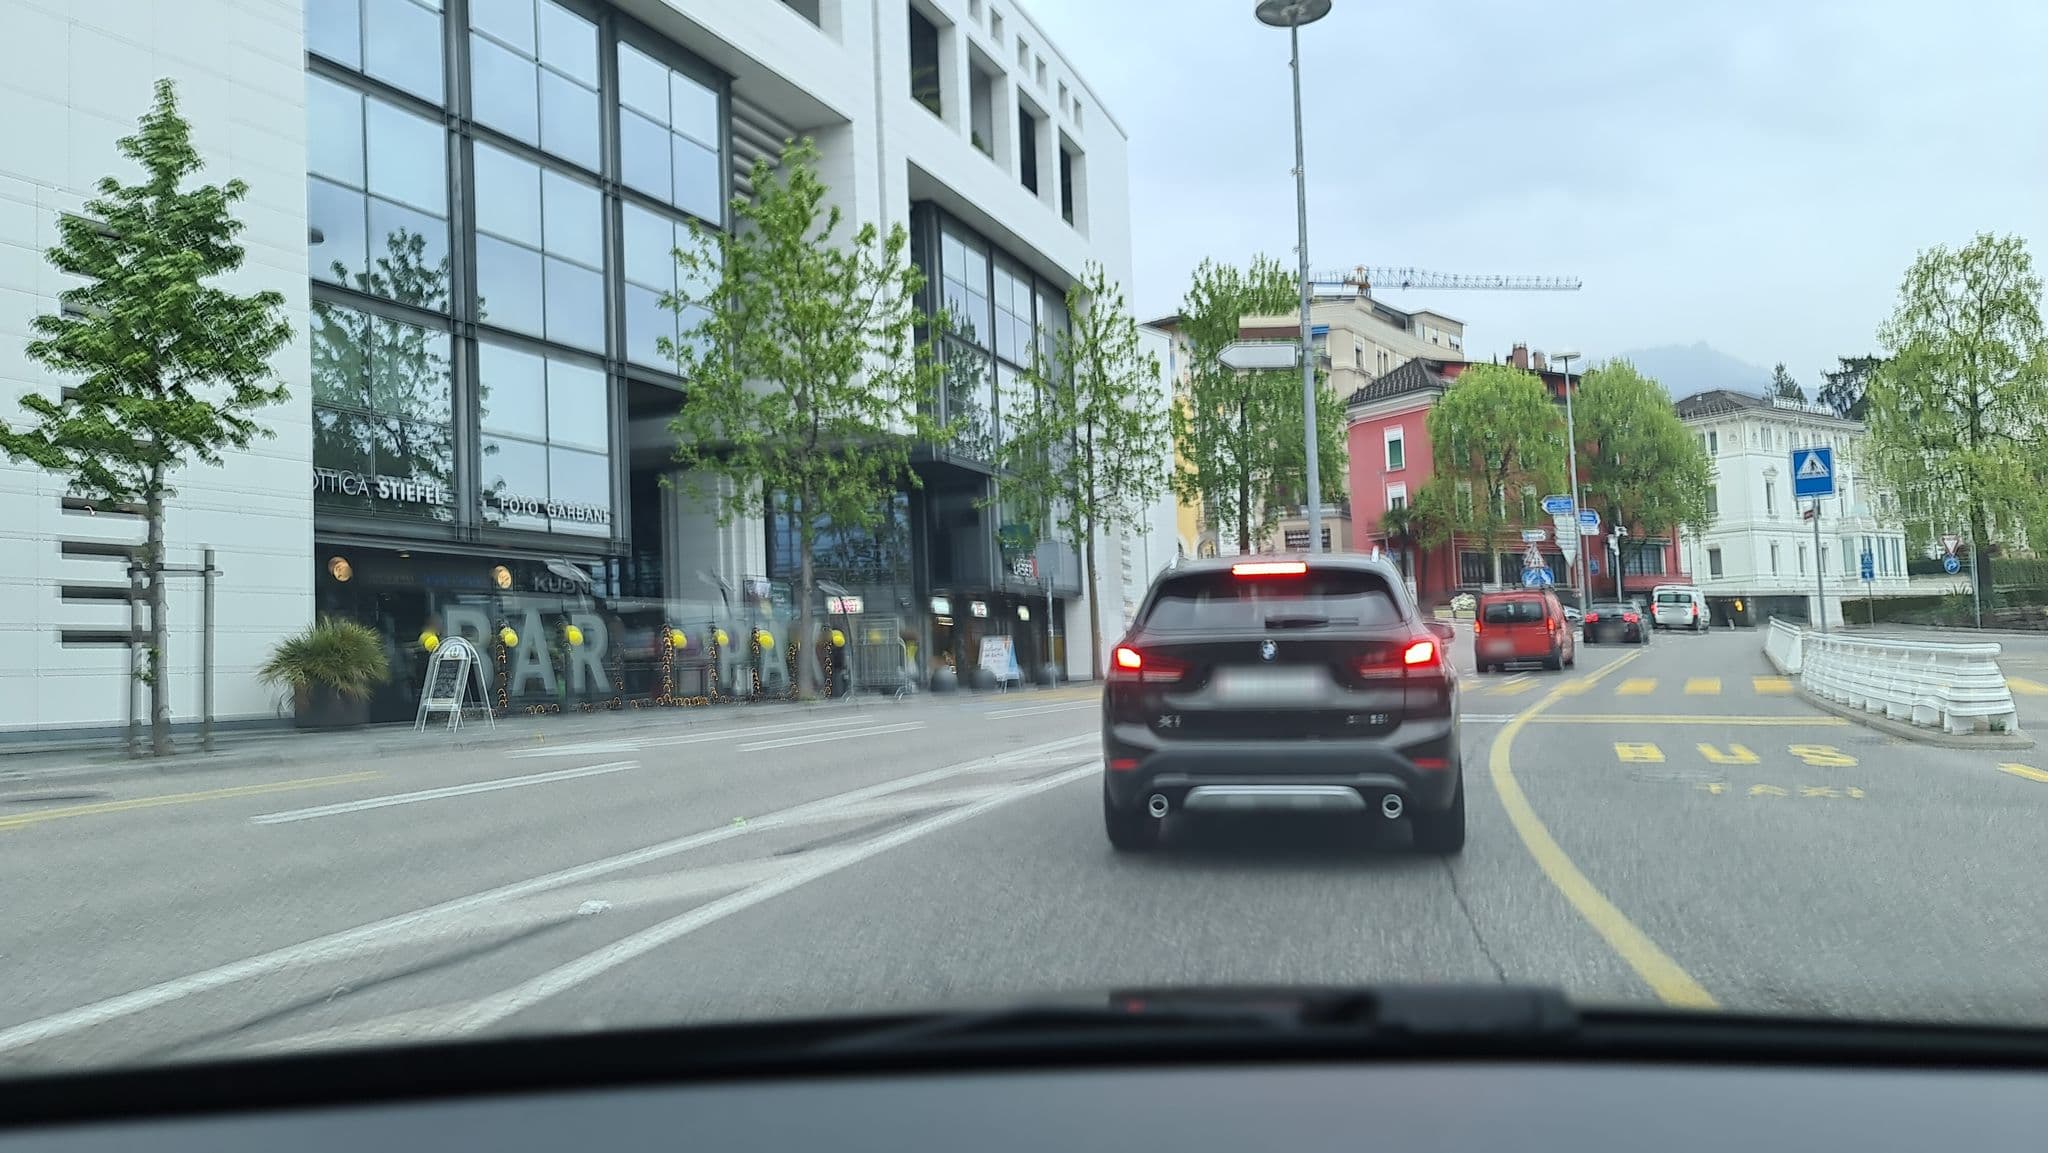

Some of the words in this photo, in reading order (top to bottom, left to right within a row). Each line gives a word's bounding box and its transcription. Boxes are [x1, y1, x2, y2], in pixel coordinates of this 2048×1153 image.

[379, 481, 444, 504] STIEFEL
[500, 496, 538, 516] FOTO
[547, 502, 608, 524] GARBANI
[446, 606, 612, 695] BAR
[1613, 742, 1859, 768] BUS
